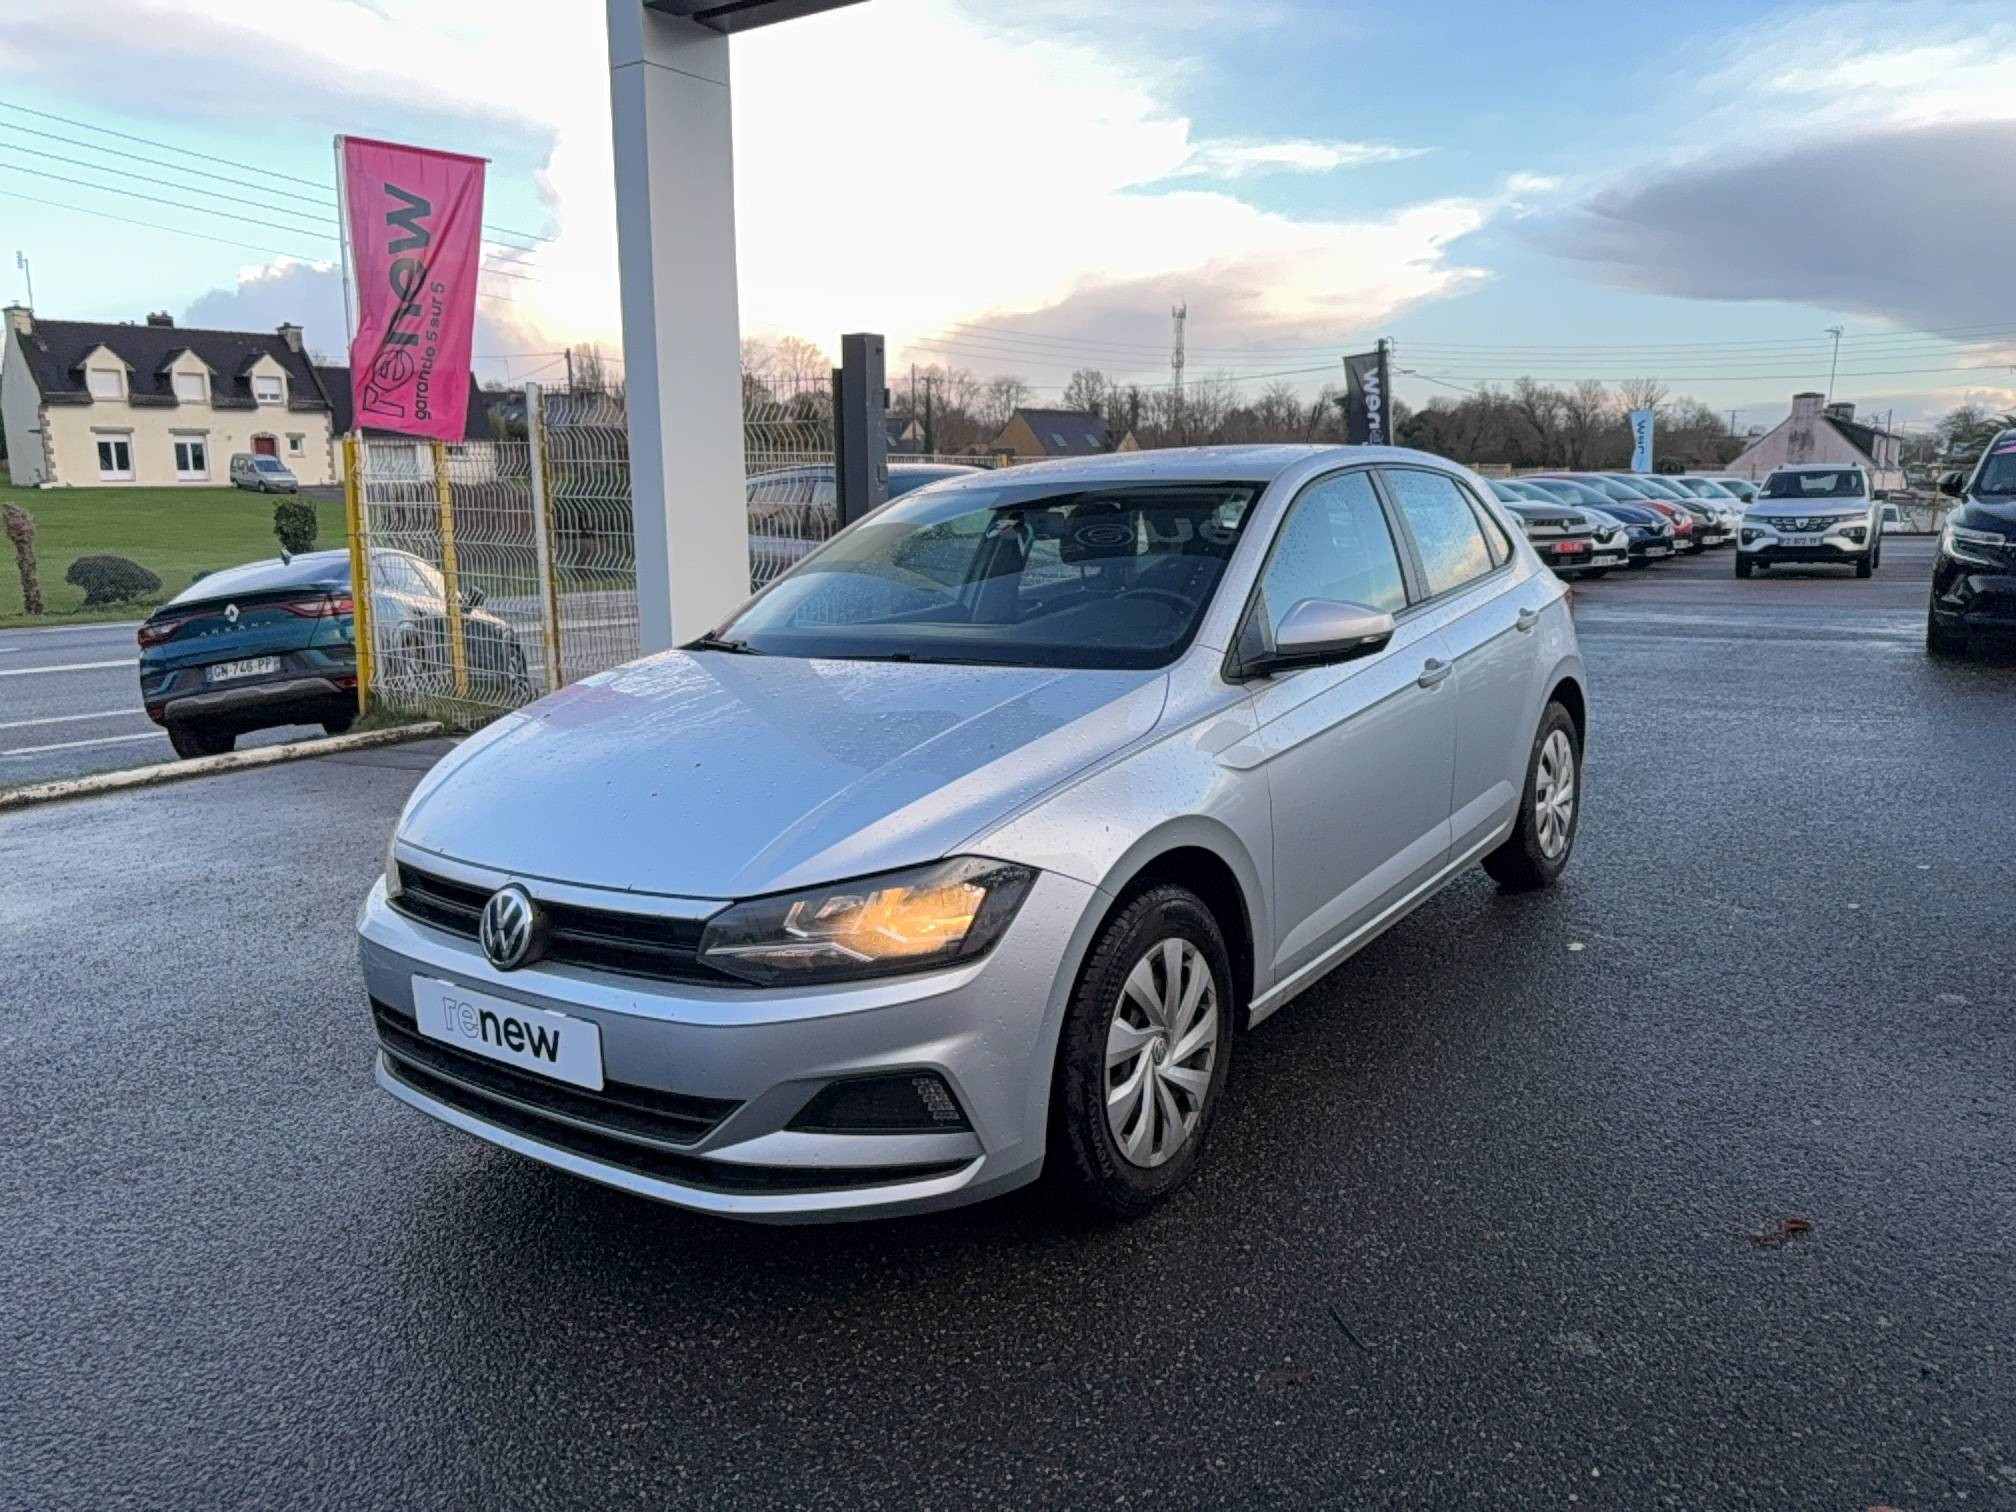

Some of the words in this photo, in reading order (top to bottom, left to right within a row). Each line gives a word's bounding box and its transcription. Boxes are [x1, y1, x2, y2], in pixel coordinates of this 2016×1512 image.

[363, 182, 432, 418] renew
[430, 282, 445, 294] 5
[430, 296, 443, 327] sur
[425, 330, 438, 341] 5
[415, 346, 436, 419] garantie
[442, 997, 560, 1063] renew
